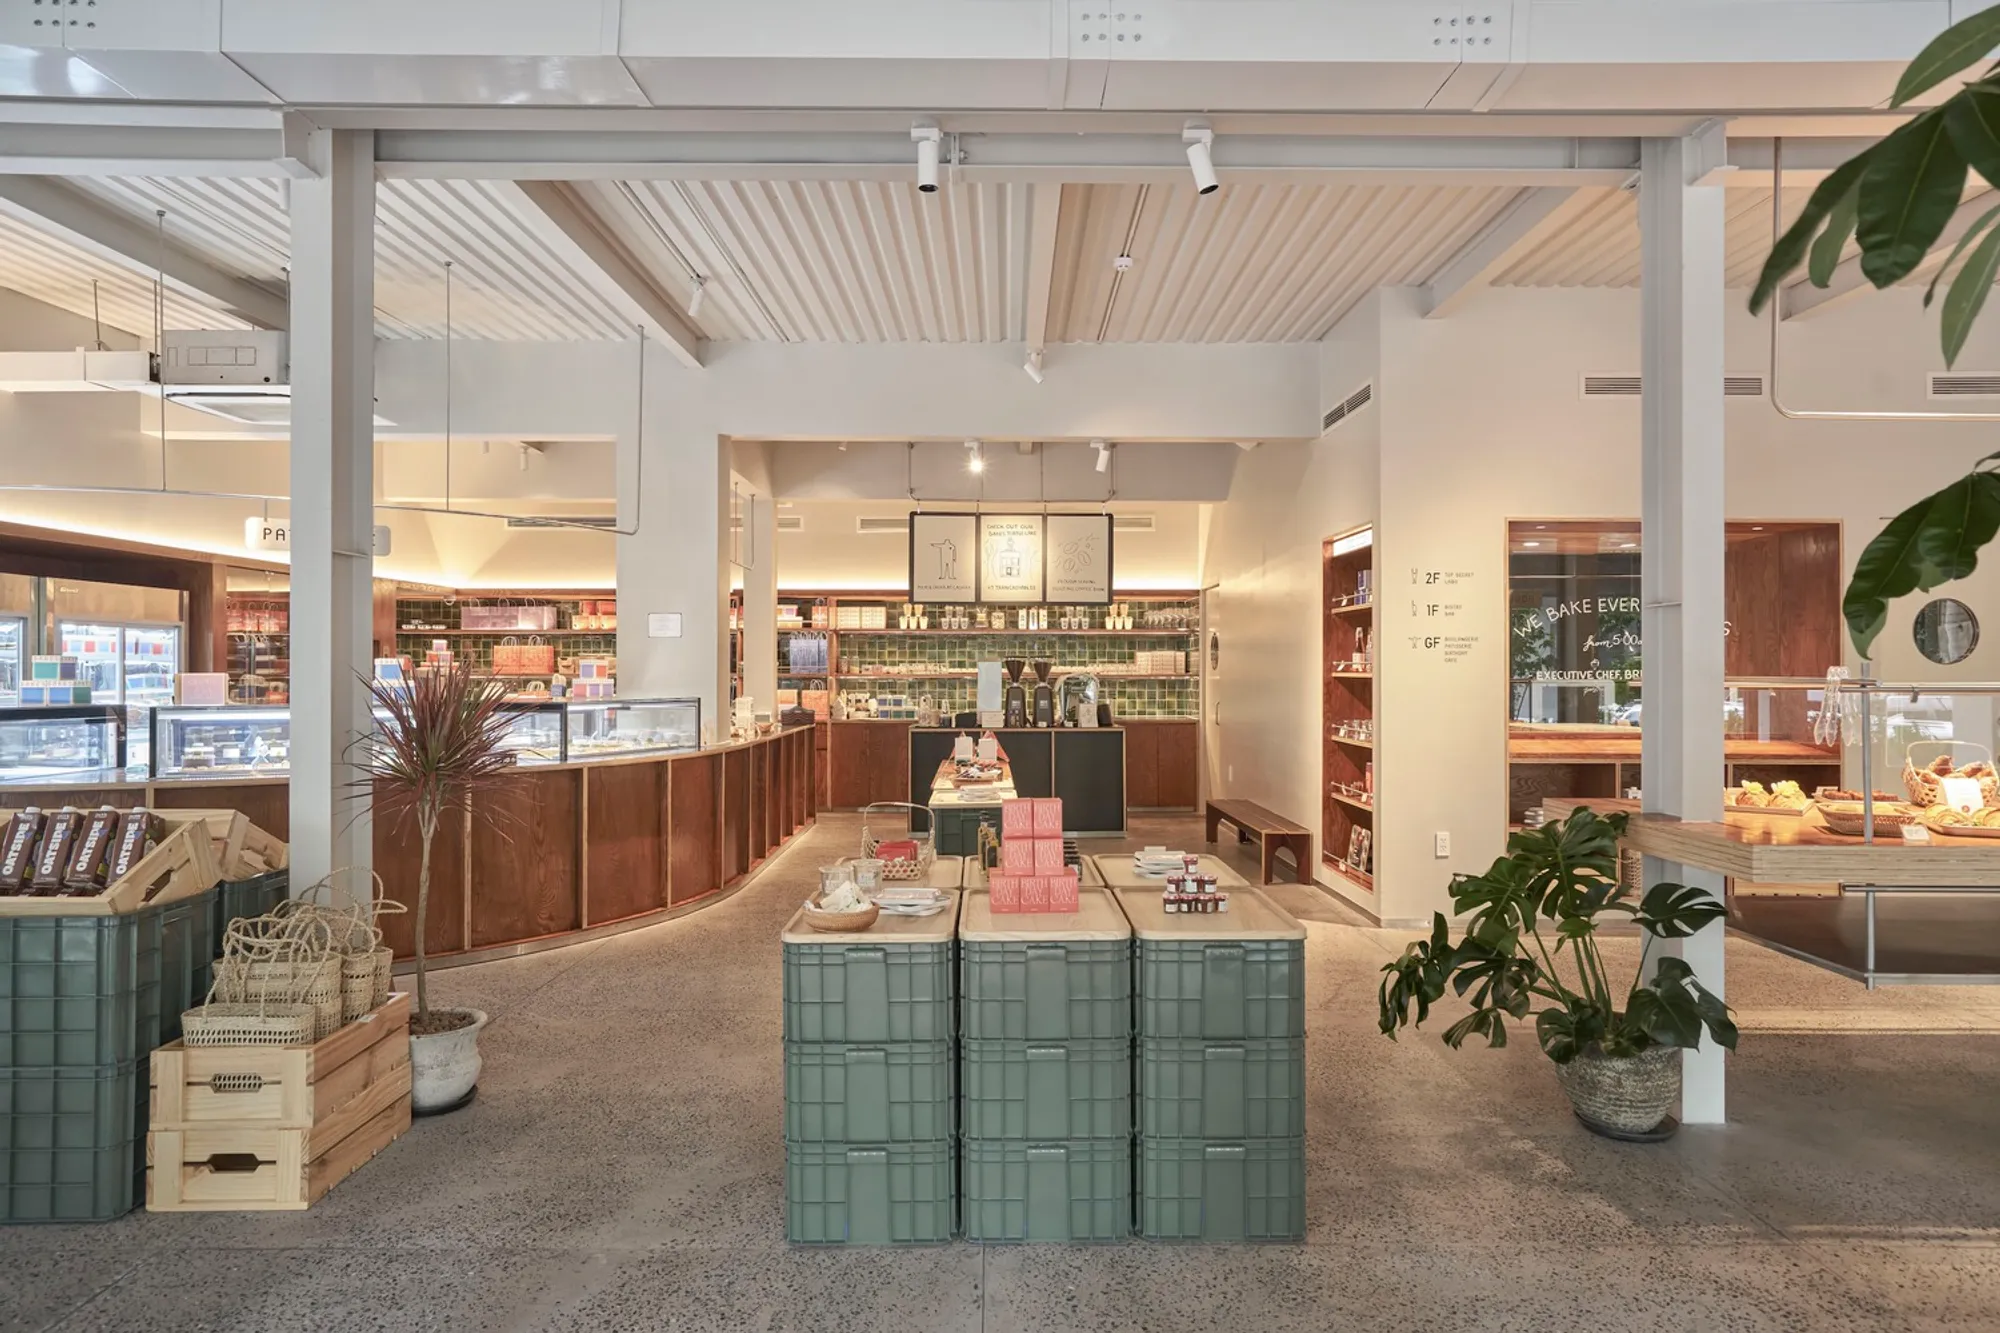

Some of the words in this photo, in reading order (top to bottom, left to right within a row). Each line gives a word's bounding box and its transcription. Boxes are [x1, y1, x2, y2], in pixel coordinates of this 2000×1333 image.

[1425, 572, 1441, 584] 2F
[1426, 604, 1440, 616] 1F
[1513, 614, 1543, 638] WE
[1545, 598, 1592, 622] BAKE
[1424, 636, 1441, 649] GF
[1583, 634, 1613, 652] from
[1536, 670, 1594, 680] EXECUTIVE
[3, 823, 30, 875] OATSIDE
[41, 822, 67, 875] OATSIDE
[76, 821, 104, 872] OATSIDE
[116, 822, 139, 875] OATSIDE
